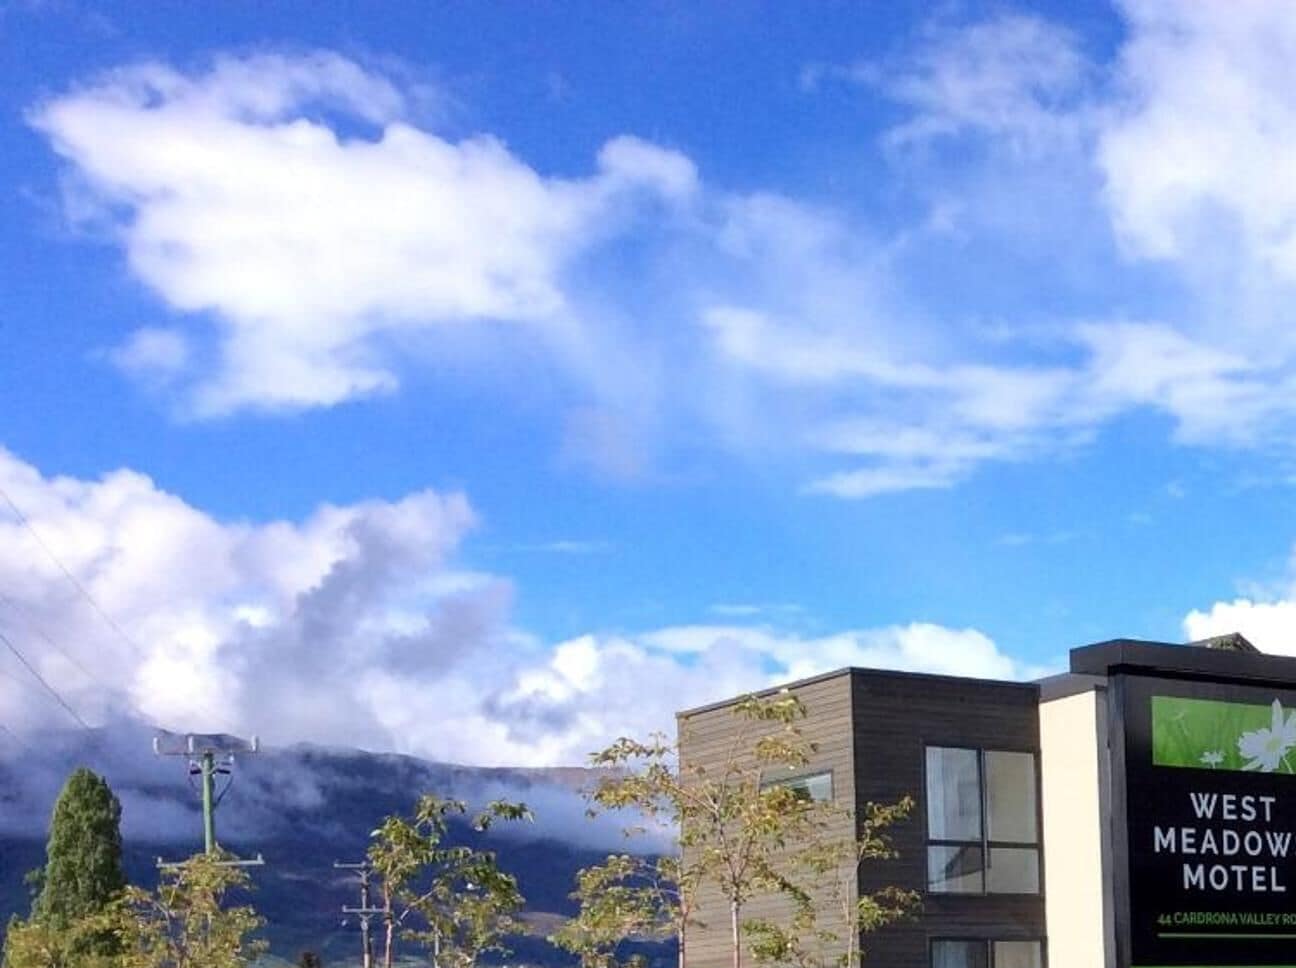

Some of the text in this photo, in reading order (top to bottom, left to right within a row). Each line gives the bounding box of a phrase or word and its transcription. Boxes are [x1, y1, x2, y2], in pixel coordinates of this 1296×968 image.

[1189, 792, 1276, 822] WEST
[1182, 863, 1287, 892] MOTEL
[1157, 913, 1172, 926] 44
[1173, 911, 1239, 925] CARDRONA
[1239, 912, 1281, 926] VALLEY
